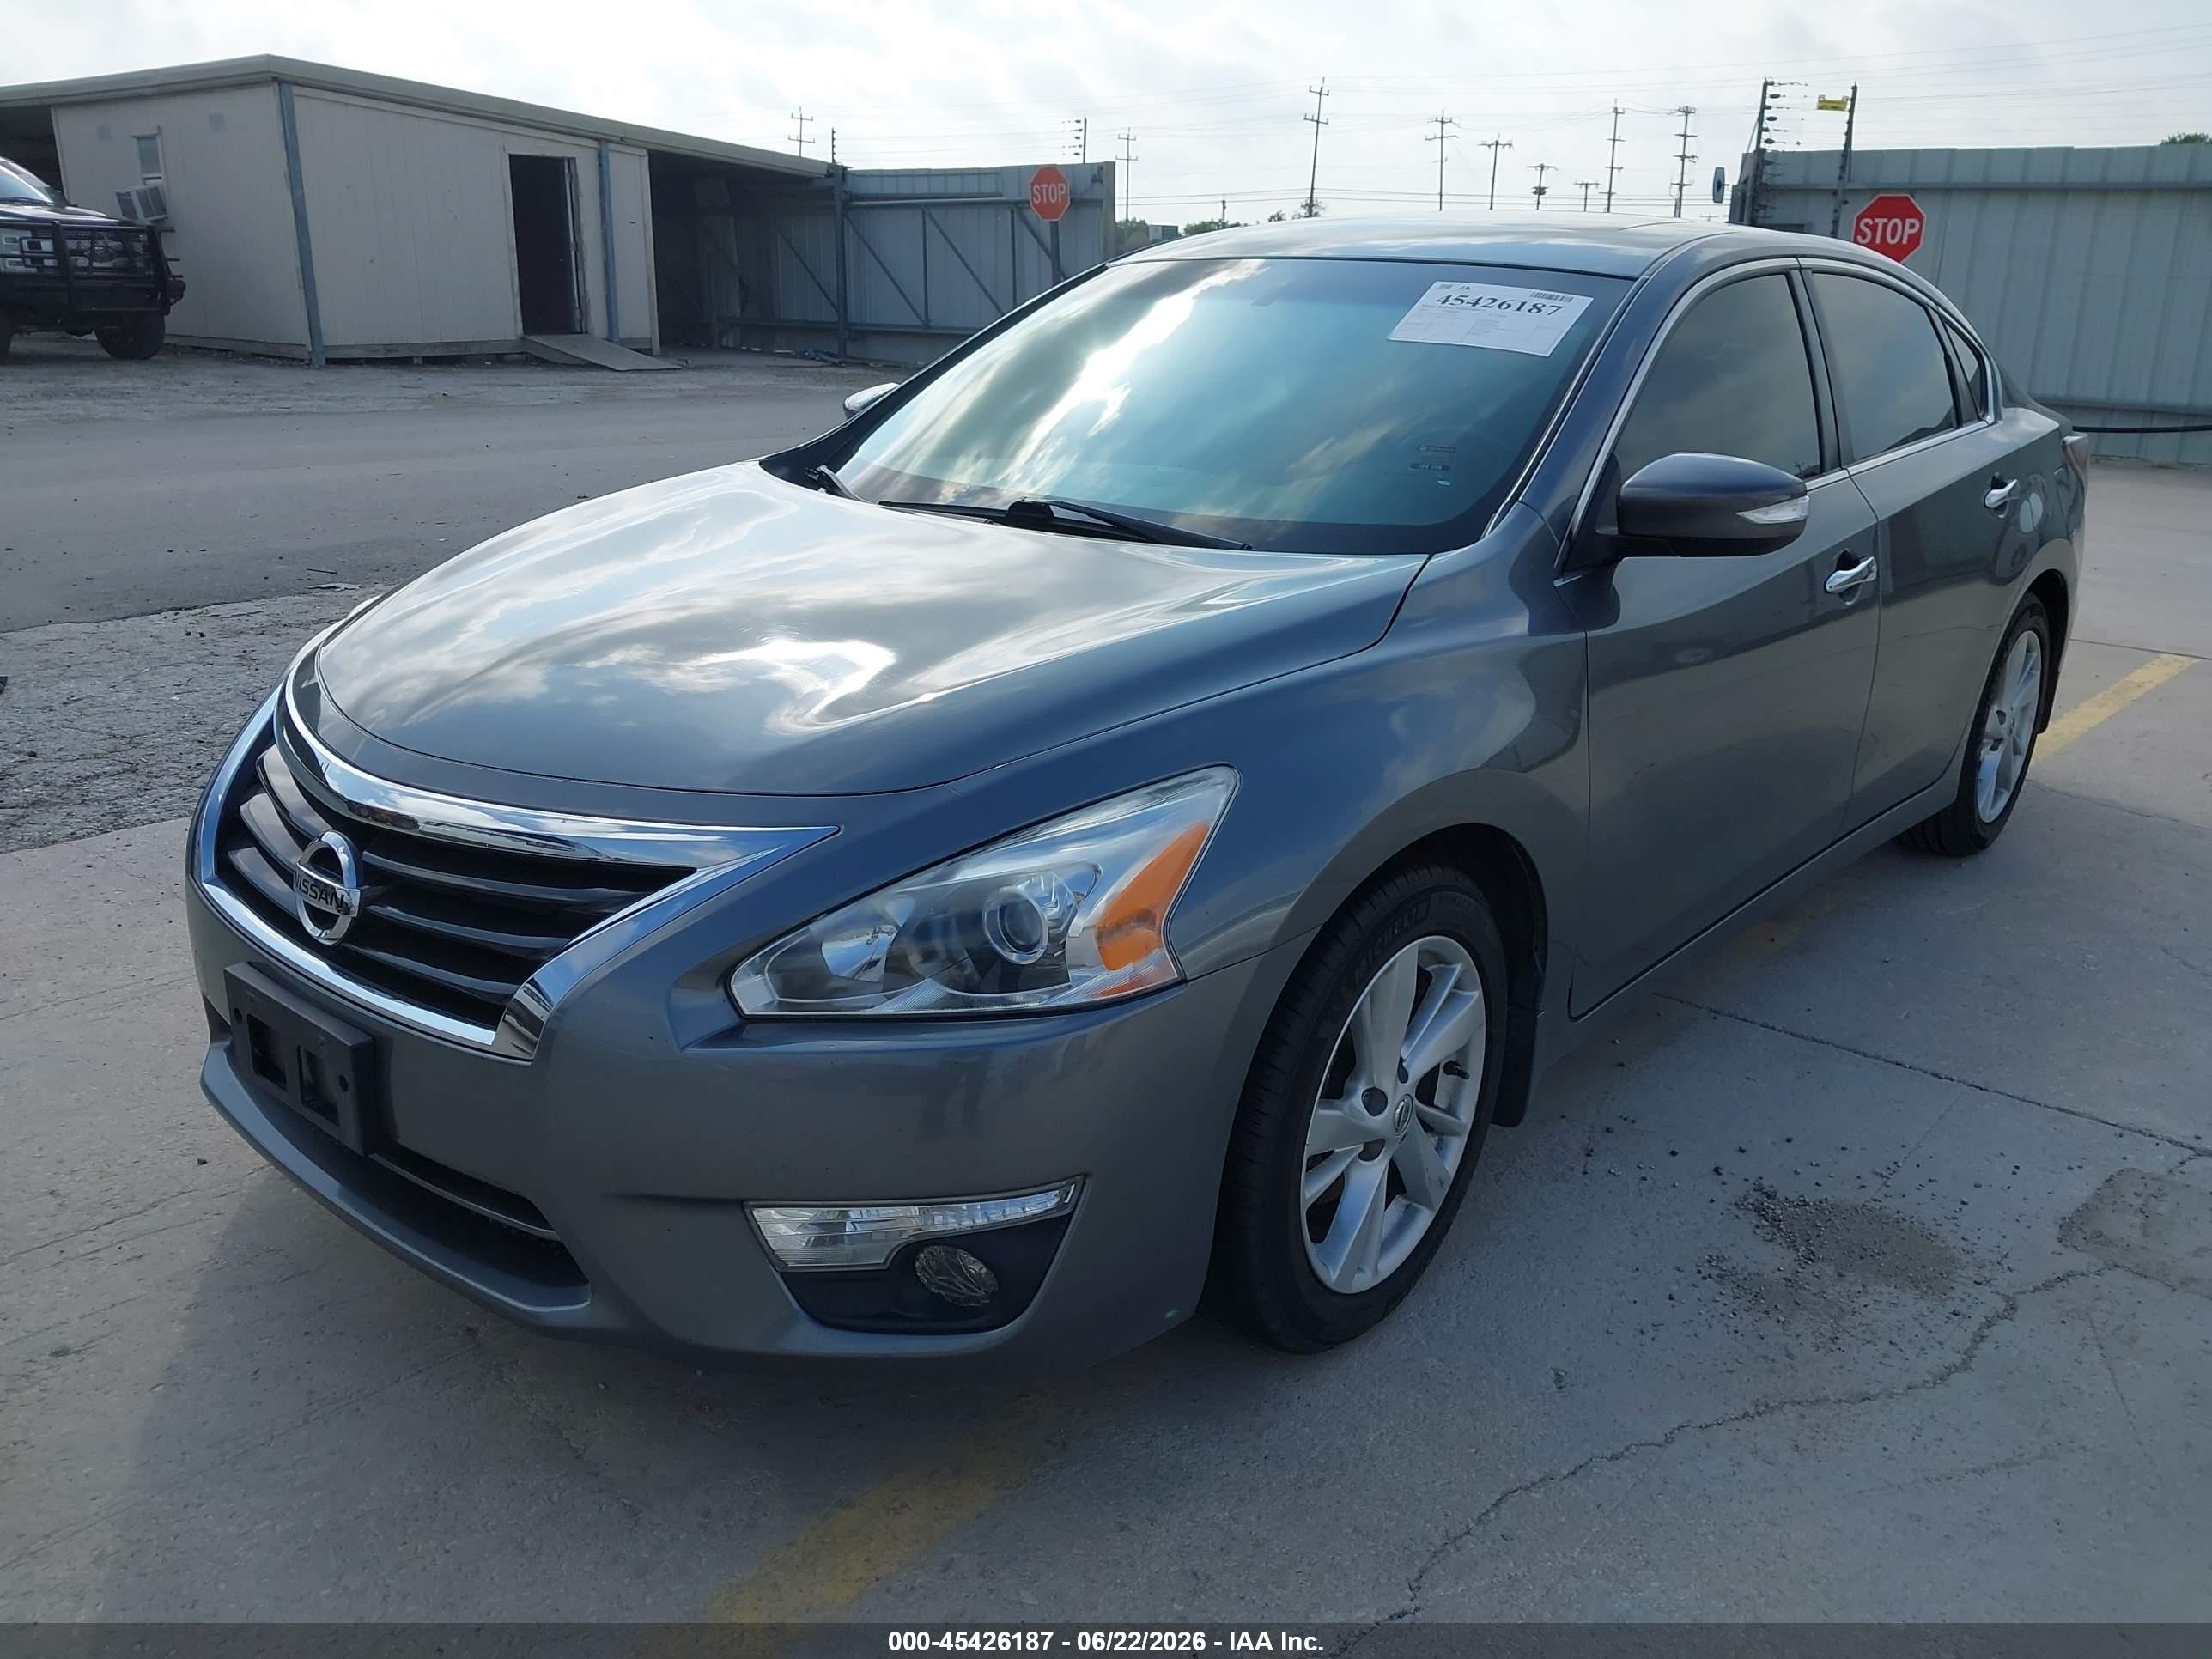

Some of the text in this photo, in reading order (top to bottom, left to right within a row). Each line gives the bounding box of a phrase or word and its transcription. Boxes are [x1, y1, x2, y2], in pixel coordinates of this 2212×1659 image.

[1033, 183, 1066, 204] STOP
[1856, 217, 1920, 245] STOP
[1435, 294, 1564, 317] 45426187
[293, 871, 345, 910] NISSAN
